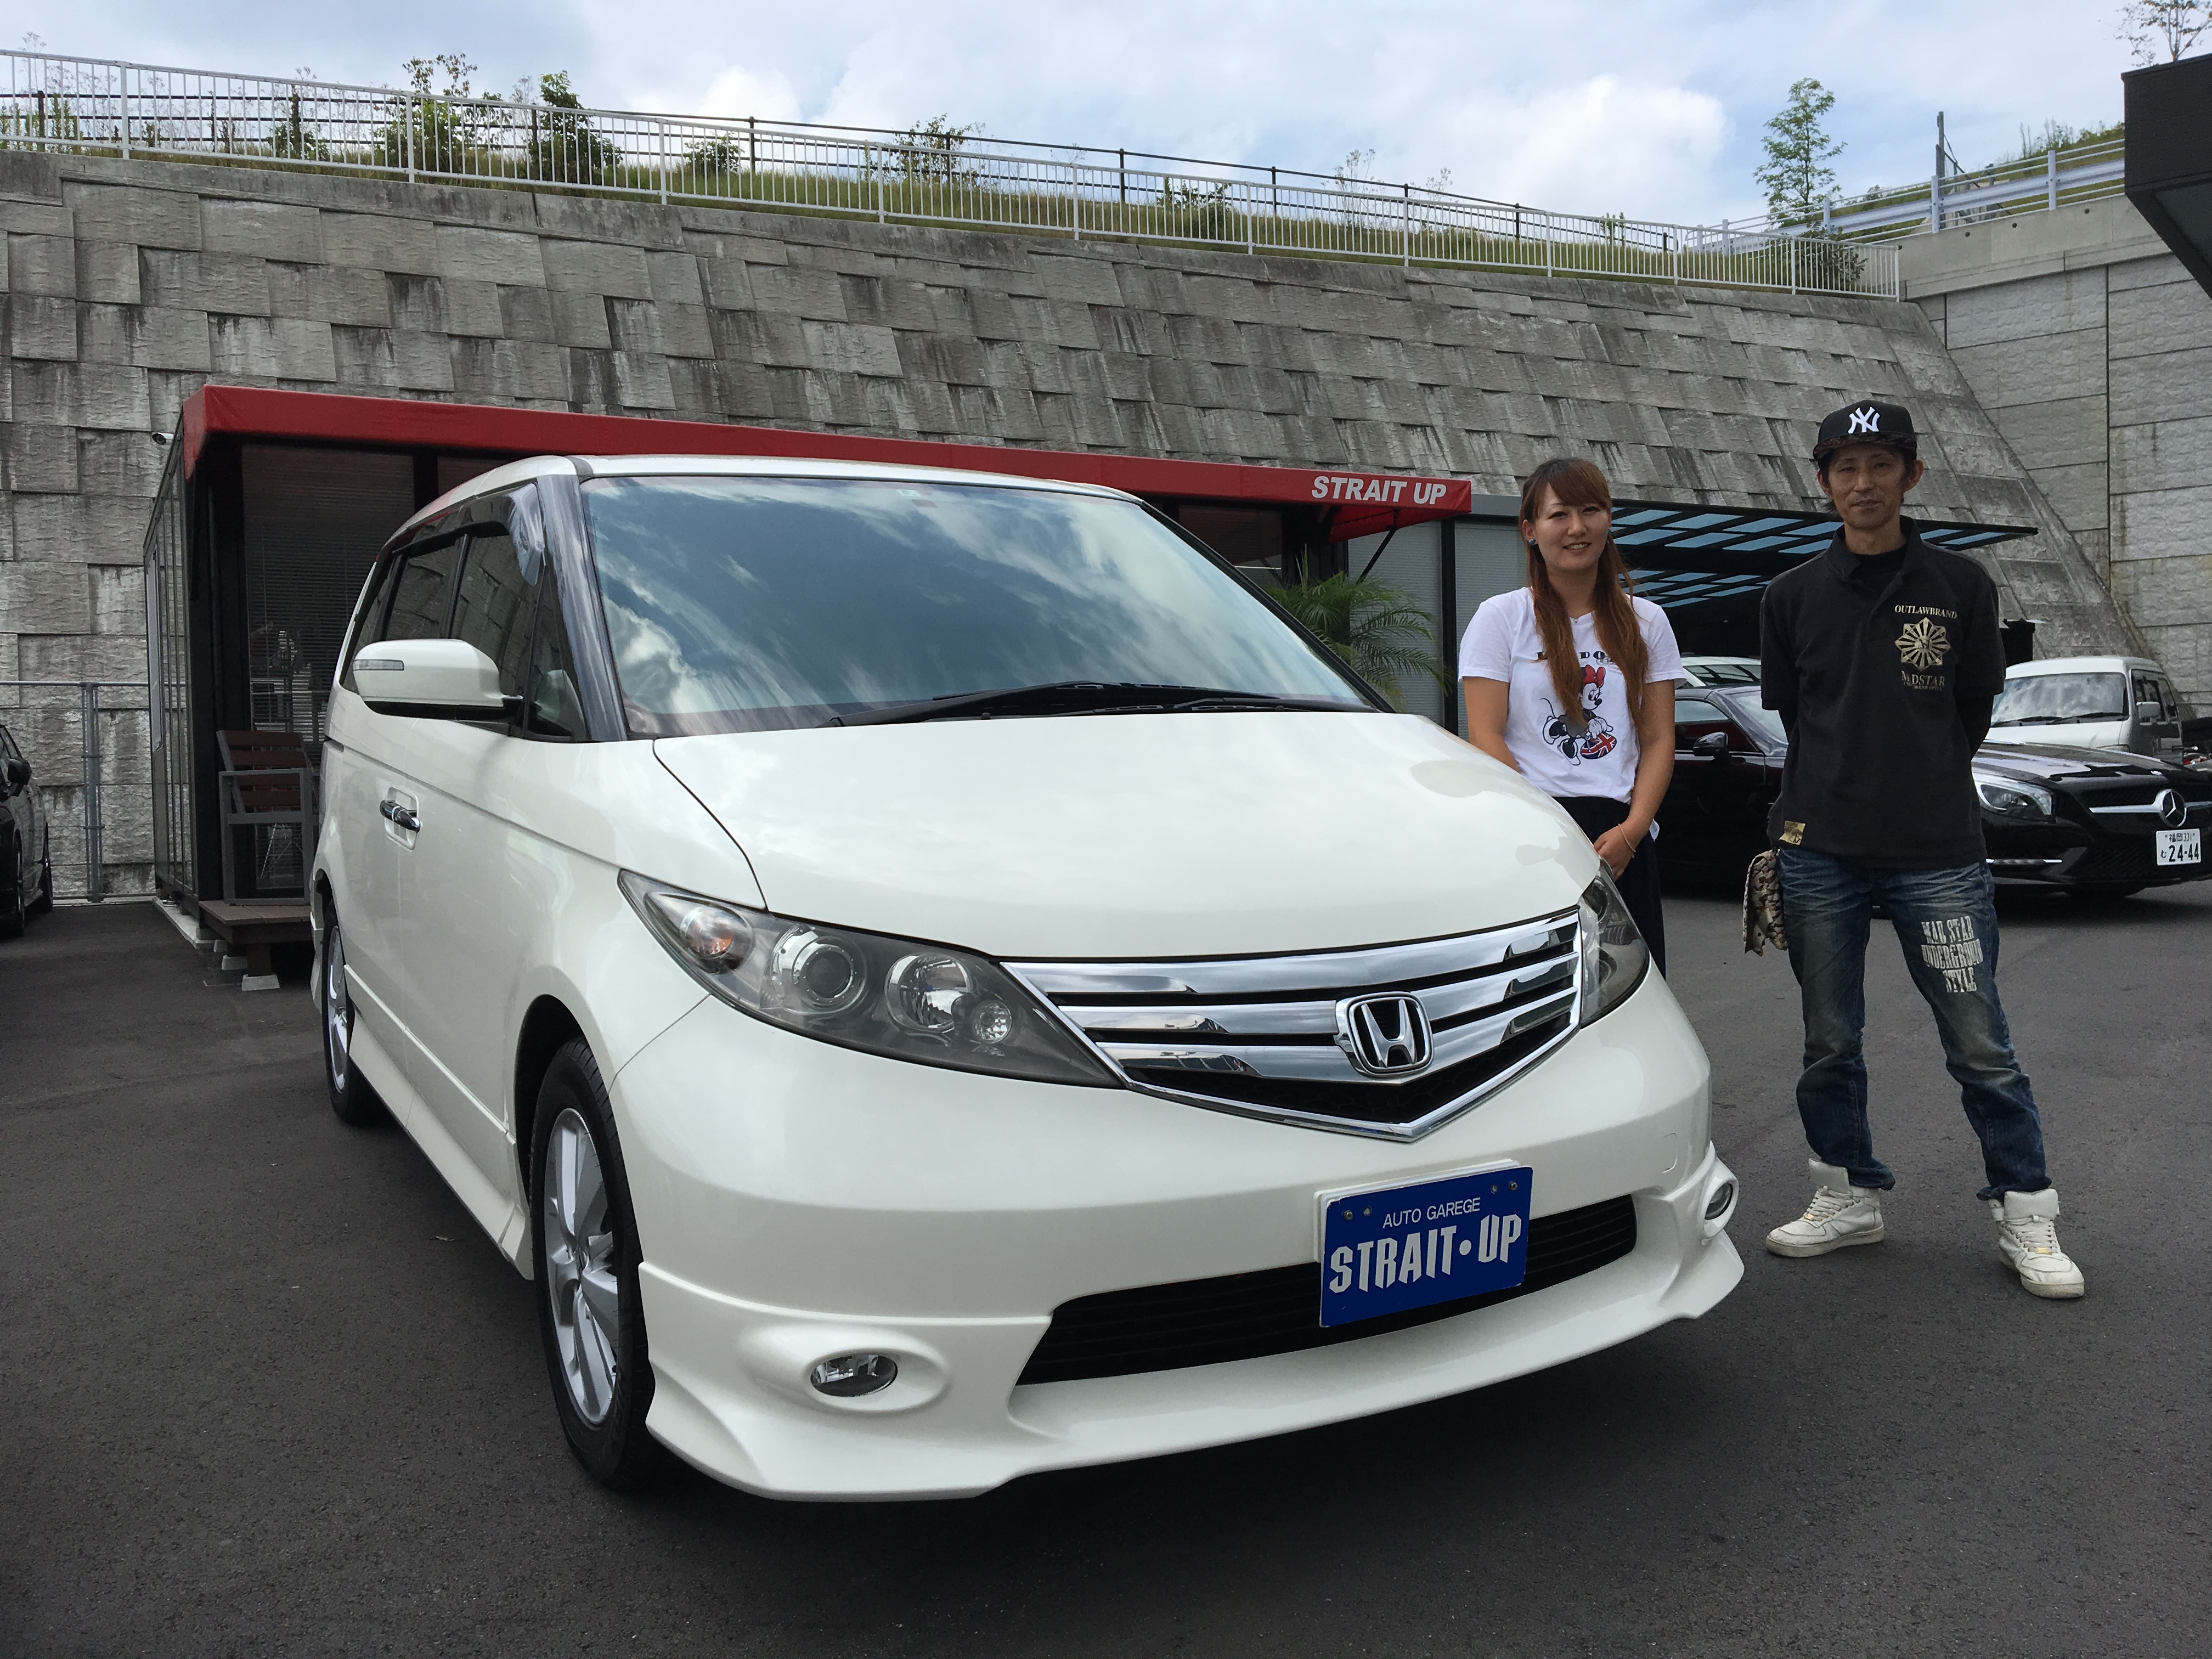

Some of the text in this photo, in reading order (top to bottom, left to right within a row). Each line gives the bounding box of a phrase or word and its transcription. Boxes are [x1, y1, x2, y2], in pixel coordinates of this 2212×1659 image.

[1311, 476, 1447, 505] STRAIT UP
[1894, 605, 1957, 619] OUTLAWBRAND
[1921, 916, 1975, 944] MAD STAR
[1943, 967, 1977, 992] STYLE
[1383, 1197, 1481, 1228] AUTO GAREGE
